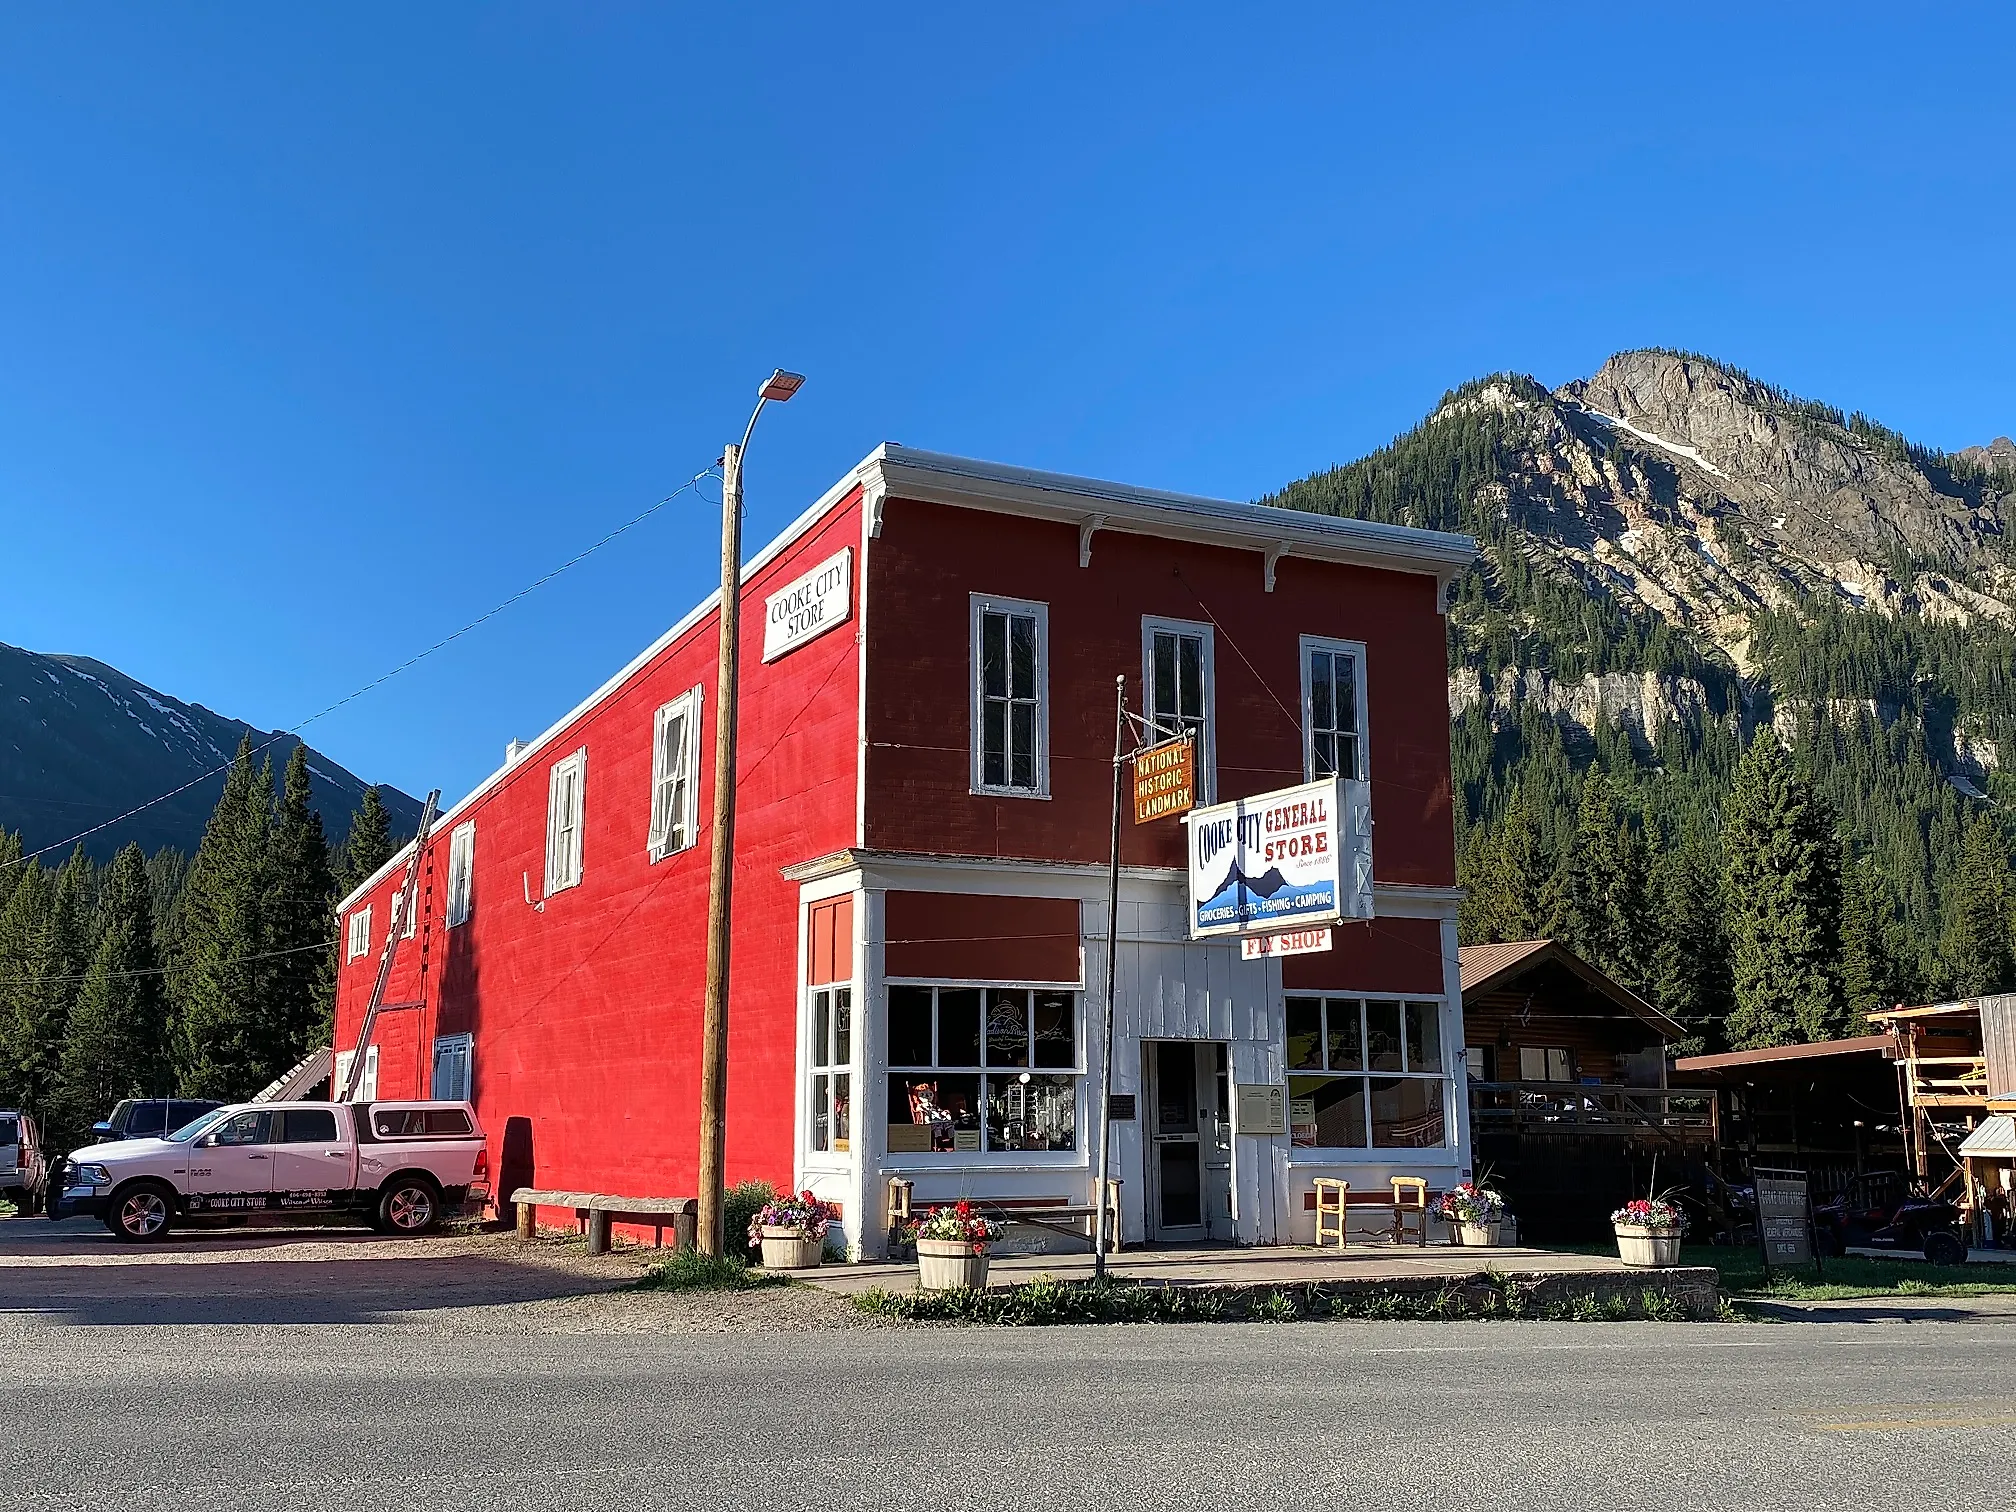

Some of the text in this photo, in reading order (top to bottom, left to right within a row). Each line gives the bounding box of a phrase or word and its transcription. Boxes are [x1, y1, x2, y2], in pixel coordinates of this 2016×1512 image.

[771, 561, 843, 624] COOKE CITY
[787, 599, 825, 639] STORE
[1138, 746, 1185, 777] NATIONAL
[1138, 768, 1182, 798] HISTORIC
[1139, 788, 1190, 819] LANDMARK
[1265, 799, 1327, 833] GENERAL
[1199, 812, 1262, 870] COOKE CITY
[1265, 832, 1328, 863] STORE
[1296, 858, 1313, 869] Since
[1199, 891, 1332, 922] GROCERIES GIFTS FISHING CAMPING
[1247, 929, 1326, 955] FLY SHOP
[210, 1197, 267, 1208] COOKE CITY STORE
